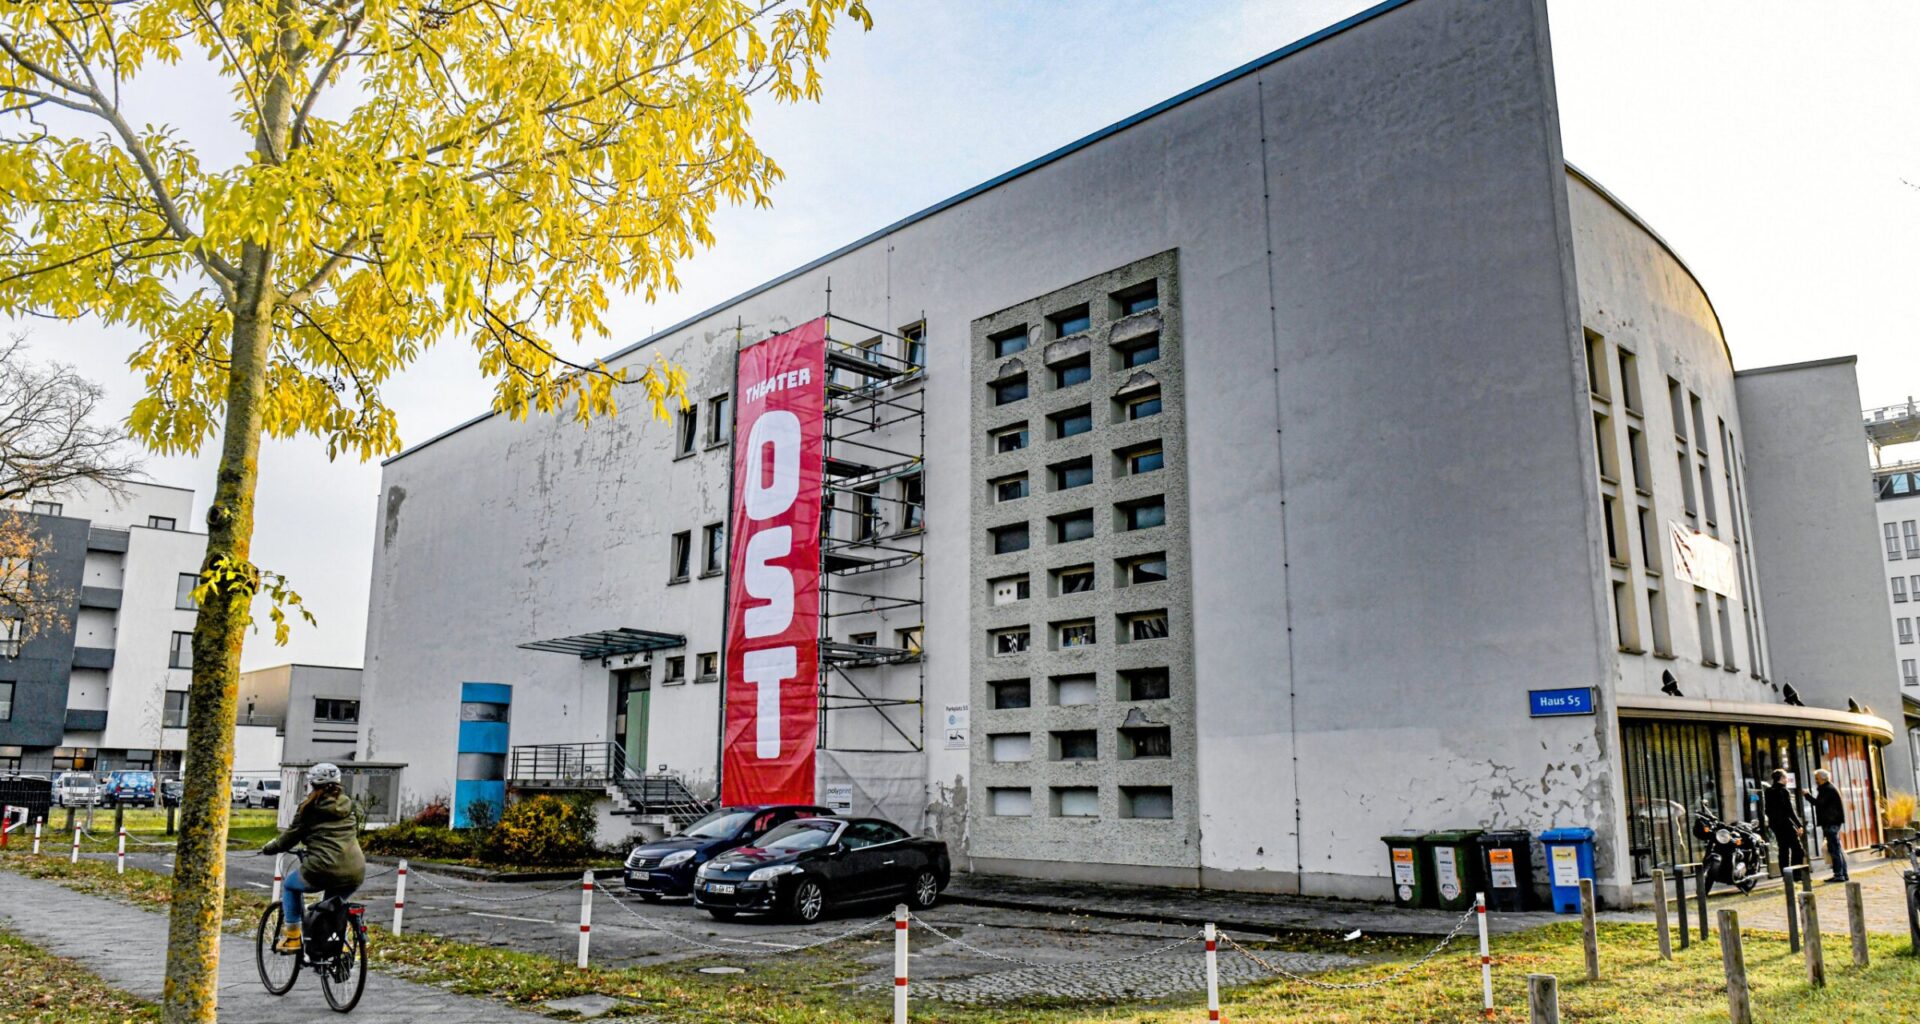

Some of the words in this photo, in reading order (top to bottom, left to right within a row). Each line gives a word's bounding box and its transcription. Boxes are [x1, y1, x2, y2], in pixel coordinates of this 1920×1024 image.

[746, 367, 811, 405] THEATER
[743, 410, 802, 760] OST
[1540, 696, 1565, 707] Haus
[1567, 694, 1581, 707] S5
